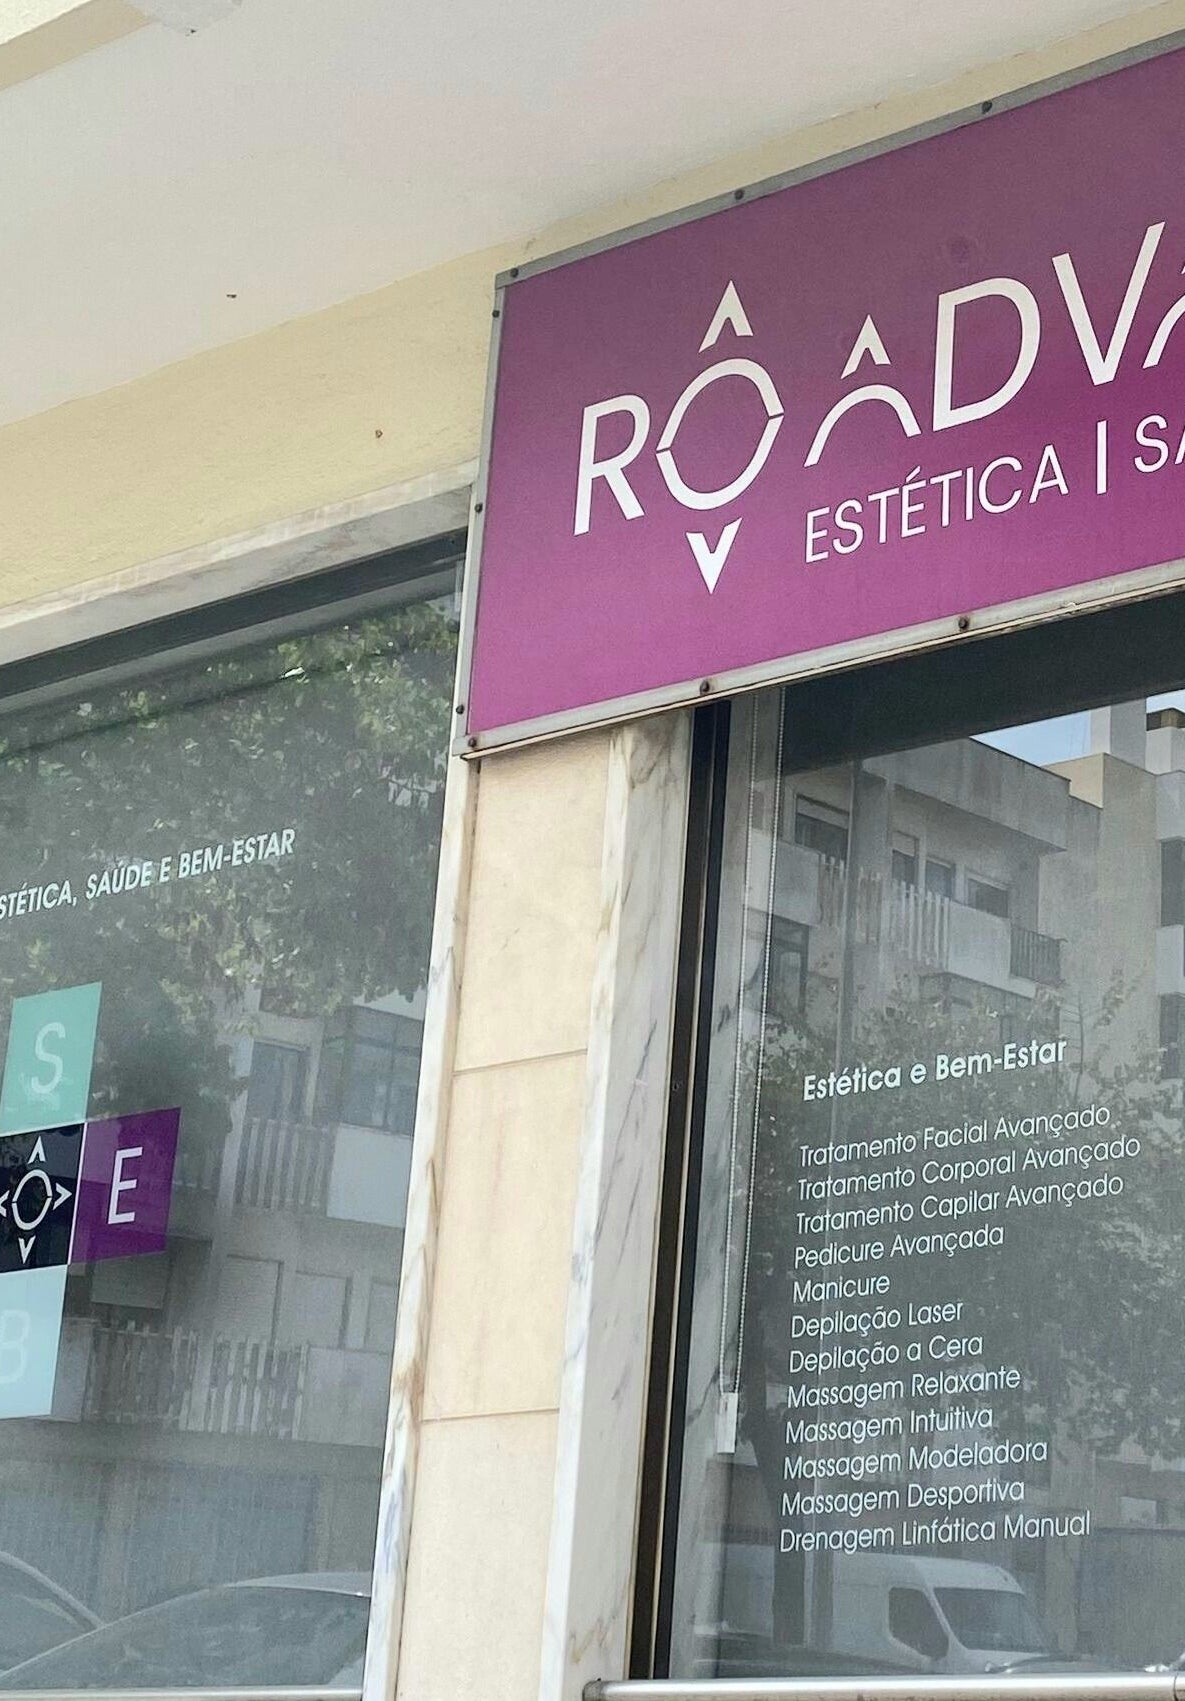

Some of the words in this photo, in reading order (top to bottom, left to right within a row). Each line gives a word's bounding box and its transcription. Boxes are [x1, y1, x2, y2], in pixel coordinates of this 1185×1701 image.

[805, 445, 1069, 564] ESTÉTICA
[85, 859, 153, 900] SAÚDE
[159, 856, 173, 883] E
[177, 828, 297, 880] BEM-ESTAR
[30, 1021, 67, 1095] S
[803, 1066, 902, 1101] Estética
[909, 1062, 927, 1085] e
[935, 1039, 1068, 1082] Bem-Estar
[800, 1132, 917, 1167] Tratamento
[923, 1120, 988, 1150] Facial
[994, 1104, 1111, 1139] Avançado
[107, 1146, 143, 1225] E
[798, 1164, 916, 1200] Tratamento
[922, 1151, 1016, 1184] Corporal
[1022, 1135, 1141, 1172] Avançado
[796, 1199, 914, 1234] Tratamento
[921, 1190, 1000, 1219] Capilar
[1005, 1174, 1124, 1208] Avançado
[794, 1237, 884, 1269] Pedicure
[890, 1224, 1005, 1257] Avançada
[793, 1275, 890, 1303] Manicure
[791, 1305, 901, 1339] Depilação
[908, 1300, 964, 1326] Laser
[789, 1341, 899, 1374] Depilação
[906, 1342, 921, 1362] a
[928, 1334, 984, 1360] Cera
[787, 1379, 904, 1409] Massagem
[911, 1366, 1021, 1397] Relaxante
[785, 1415, 902, 1444] Massagem
[910, 1406, 993, 1434] Intuitiva
[783, 1451, 901, 1480] Massagem
[908, 1440, 1048, 1471] Modeladora
[781, 1487, 899, 1518] Massagem
[907, 1480, 1025, 1511] Desportiva
[780, 1526, 895, 1555] Drenagem
[902, 1516, 996, 1546] Linfática
[1003, 1510, 1091, 1540] Manual
